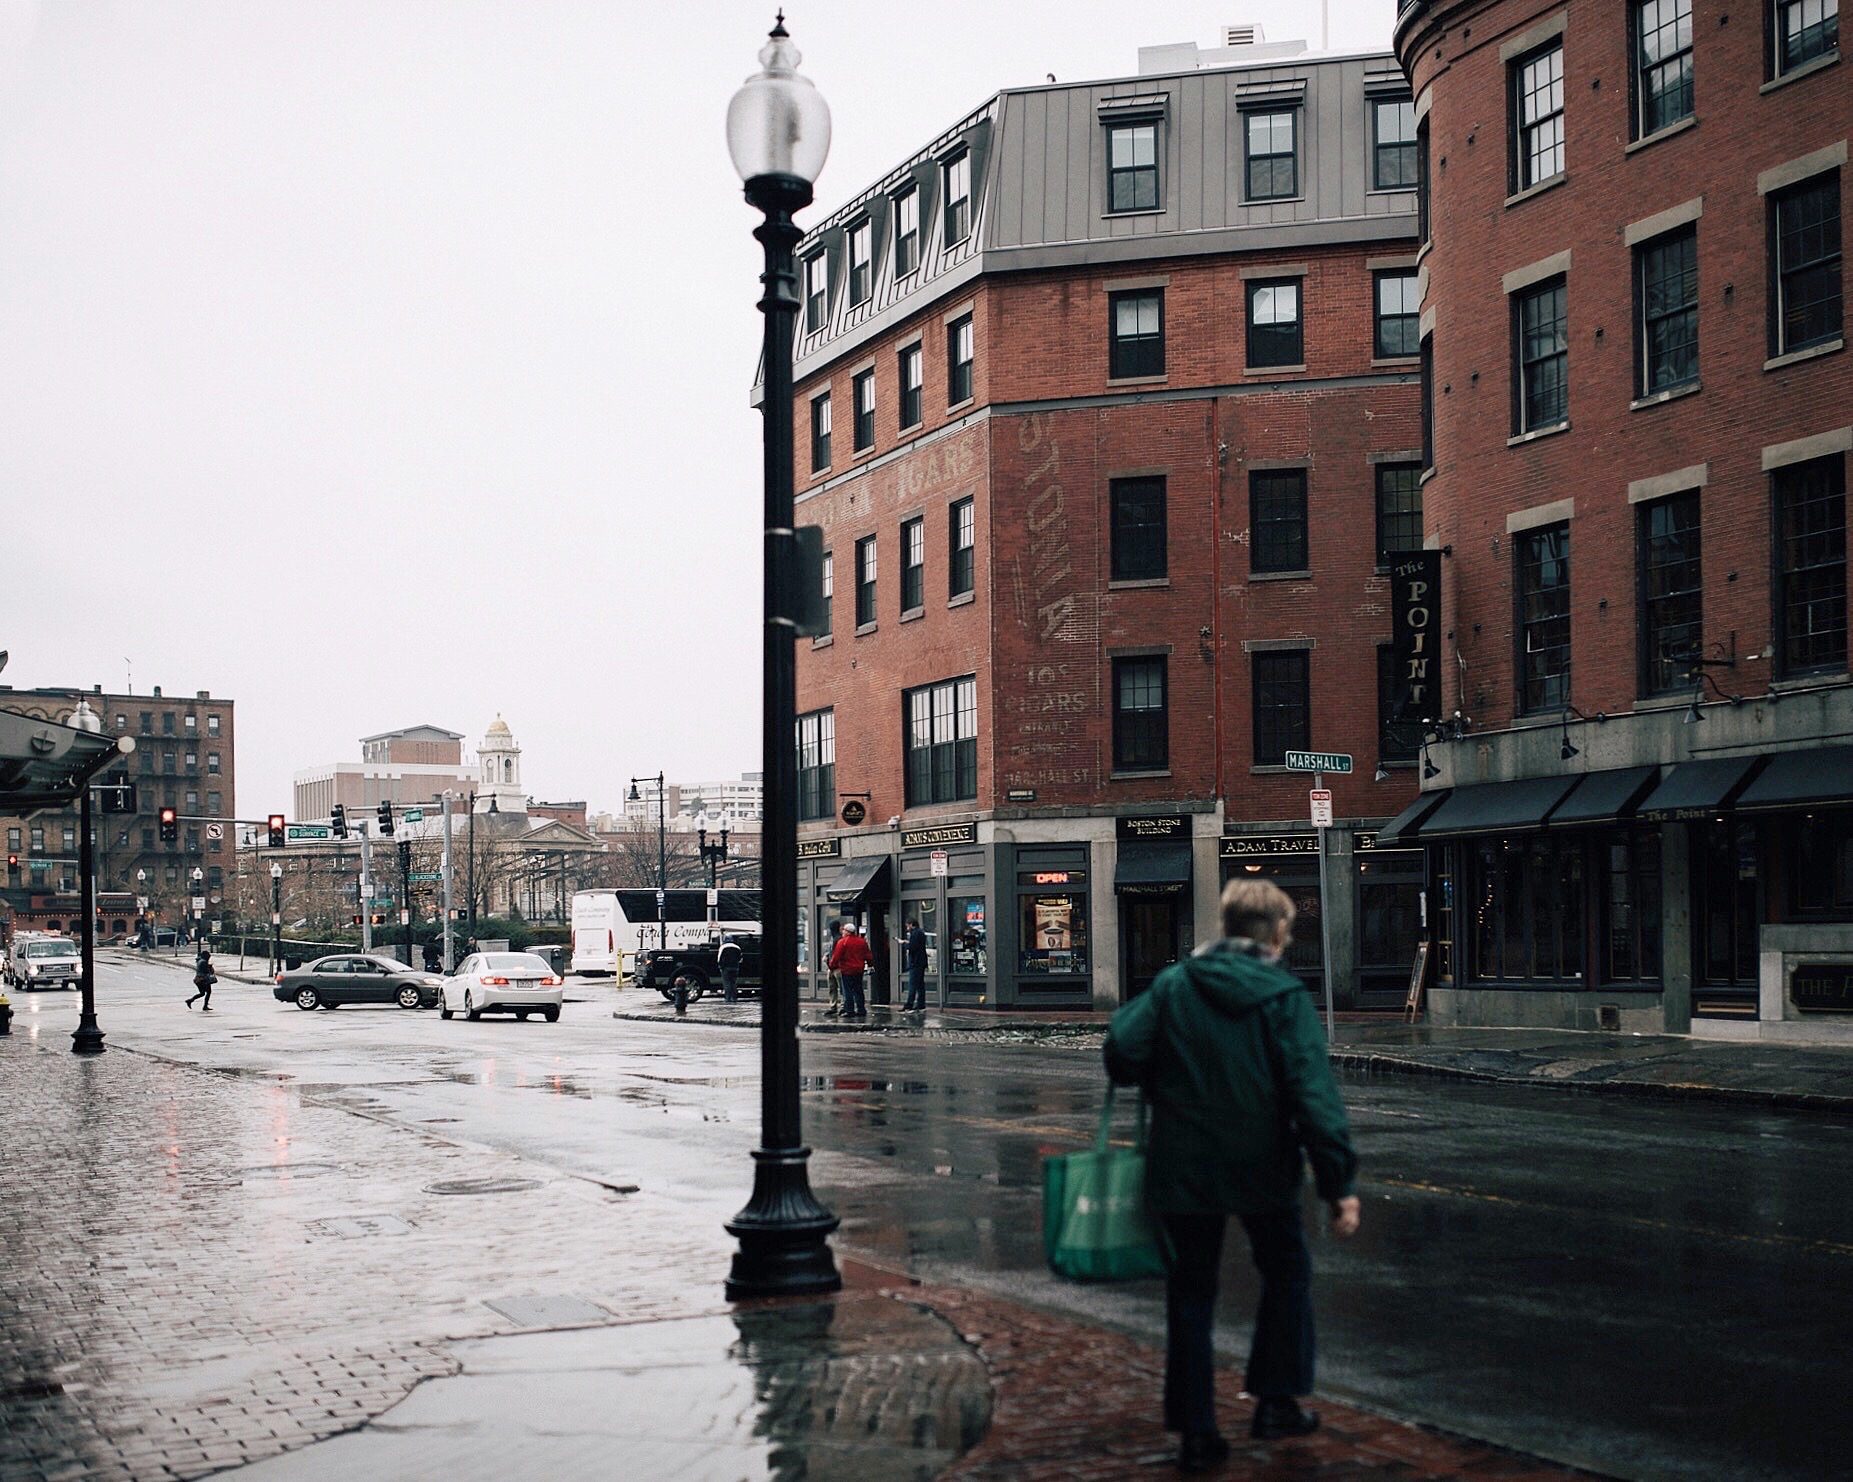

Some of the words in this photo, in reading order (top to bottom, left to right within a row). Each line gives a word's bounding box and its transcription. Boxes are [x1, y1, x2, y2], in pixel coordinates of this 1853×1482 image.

[1396, 561, 1424, 576] The
[1407, 581, 1429, 704] POINT
[1289, 754, 1341, 770] MARSHALL
[1648, 810, 1668, 821] The
[1676, 808, 1705, 820] Point
[1127, 819, 1156, 827] BOSTON
[1137, 826, 1171, 835] BUILDING
[1225, 842, 1267, 853] ADAM
[1270, 839, 1320, 851] TRAVEL
[1036, 873, 1068, 883] OPEN
